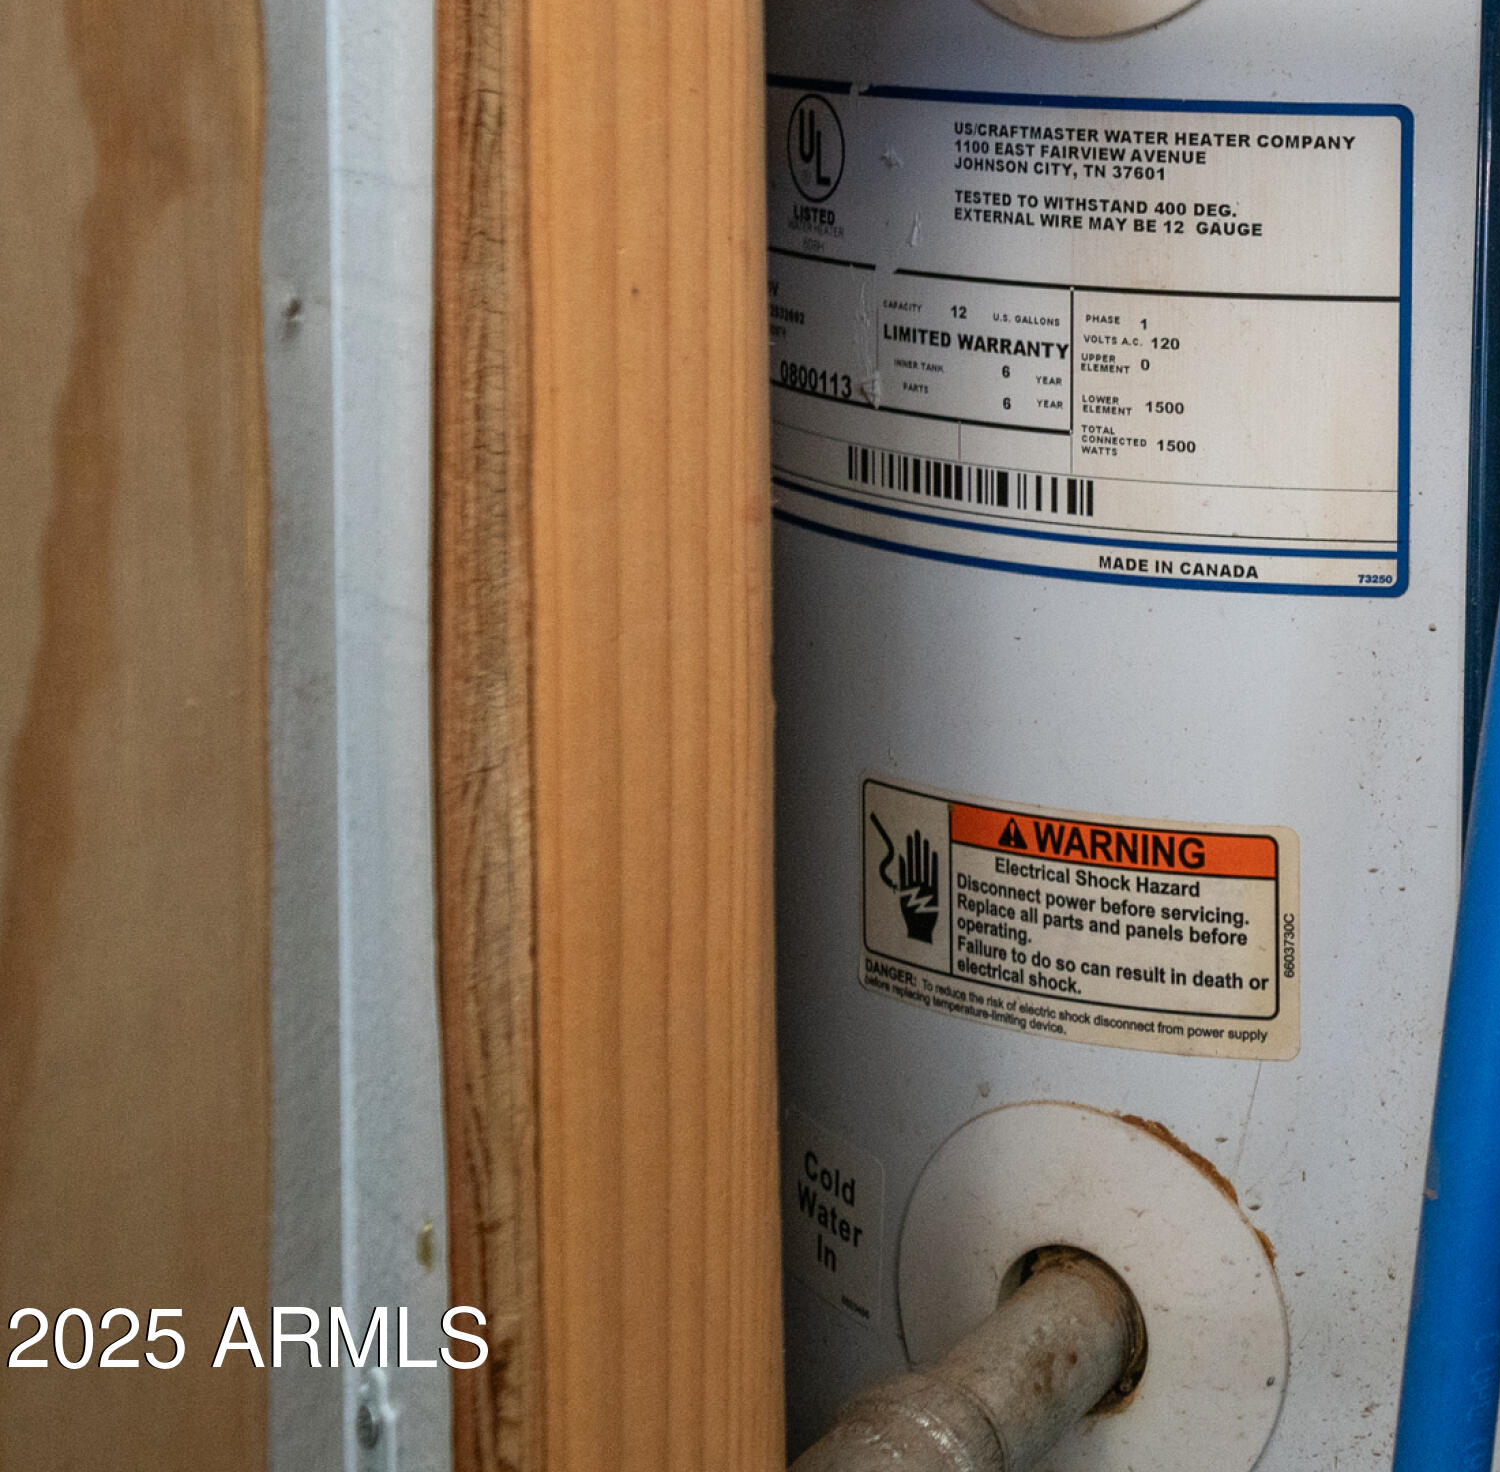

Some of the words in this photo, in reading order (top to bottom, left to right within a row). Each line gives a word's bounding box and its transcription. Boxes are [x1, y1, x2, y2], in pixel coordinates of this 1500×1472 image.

[955, 122, 1099, 145] US/CRAFTMASTER
[1104, 129, 1169, 146] WATER
[1175, 132, 1251, 149] HEATER
[1256, 135, 1356, 151] COMPANY
[955, 139, 989, 155] 1100
[994, 141, 1035, 158] EAST
[1040, 144, 1126, 163] FAIRVIEW
[1130, 148, 1207, 165] AVENUE
[955, 157, 1028, 173] JOHNSON
[1033, 161, 1079, 180] CITY,
[1083, 164, 1107, 179] TN
[1112, 165, 1166, 181] 37601
[955, 190, 1012, 209] TESTED
[1017, 194, 1040, 209] TO
[1043, 196, 1149, 216] WITHSTAND
[1154, 201, 1187, 216] 400
[1193, 202, 1238, 218] DEG.
[955, 207, 1036, 227] EXTERNAL
[1040, 213, 1084, 230] WIRE
[1088, 215, 1129, 233] MAY
[1134, 218, 1158, 233] BE
[1163, 219, 1185, 235] 12
[1196, 220, 1263, 237] GAUGE
[950, 305, 968, 320] 12
[992, 313, 1010, 324] U.S.
[1014, 315, 1060, 327] GALLONS
[1085, 314, 1121, 325] PHASE
[1139, 317, 1148, 331] 1
[883, 323, 952, 349] LIMITED
[957, 334, 1070, 360] WARRANTY
[1083, 334, 1118, 347] VOLTS
[1121, 337, 1143, 348] A.C.
[1150, 336, 1180, 351] 120
[1079, 363, 1130, 376] ELEMENT
[1140, 357, 1150, 373] 0
[1080, 352, 1117, 365] UPPER
[779, 359, 853, 400] 0800113
[1001, 365, 1011, 379] 6
[1035, 376, 1063, 386] YEAR
[1001, 396, 1012, 412] 6
[1036, 399, 1064, 410] YEAR
[1081, 394, 1120, 407] LOWER
[1082, 404, 1133, 417] ELEMENT
[1145, 400, 1185, 415] 1500
[1080, 435, 1147, 449] CONNECTED
[1081, 425, 1116, 436] TOTAL
[1080, 445, 1118, 458] WATTS
[1156, 439, 1196, 455] 1500
[1098, 554, 1149, 574] MADE
[1154, 560, 1174, 574] IN
[1179, 561, 1260, 580] CANADA
[1357, 573, 1393, 585] 73250
[1034, 822, 1206, 870] WARNING
[995, 857, 1071, 885] Electrical
[1075, 870, 1131, 893] Shock
[1136, 876, 1200, 898] Hazard
[957, 872, 1042, 906] Disconnect
[1046, 892, 1097, 914] power
[1101, 897, 1157, 919] before
[1161, 905, 1250, 926] servicing.
[957, 893, 1016, 920] Replace
[1020, 902, 1039, 924] all
[1043, 909, 1085, 931] parts
[1089, 915, 1121, 935] and
[1125, 920, 1185, 942] panels
[1189, 926, 1248, 947] before
[957, 917, 1033, 946] operating.
[1283, 913, 1296, 978] 6603730C
[957, 935, 1008, 961] Failure
[1012, 946, 1027, 964] to
[1031, 949, 1052, 968] do
[1056, 956, 1076, 972] so
[1080, 960, 1111, 977] can
[1116, 963, 1166, 985] result
[1171, 969, 1188, 985] in
[1192, 970, 1244, 990] death
[1249, 977, 1269, 991] or
[957, 957, 1025, 983] electrical
[1029, 971, 1082, 995] shock.
[865, 958, 917, 988] DANGER:
[922, 977, 934, 991] To
[934, 980, 966, 1002] reduce
[969, 988, 985, 1004] the
[987, 991, 1004, 1009] risk
[1006, 996, 1018, 1011] of
[1019, 999, 1057, 1020] electric
[1059, 1008, 1091, 1026] shock
[1094, 1013, 1155, 1034] disconnect
[1157, 1022, 1184, 1037] from
[1187, 1027, 1224, 1041] power
[1227, 1029, 1268, 1044] supply
[893, 981, 932, 1006] replacing
[932, 991, 1027, 1029] temperature-limiting
[1029, 1017, 1067, 1036] device.
[804, 1149, 856, 1207] Cold
[798, 1178, 863, 1248] Water
[817, 1232, 838, 1273] In
